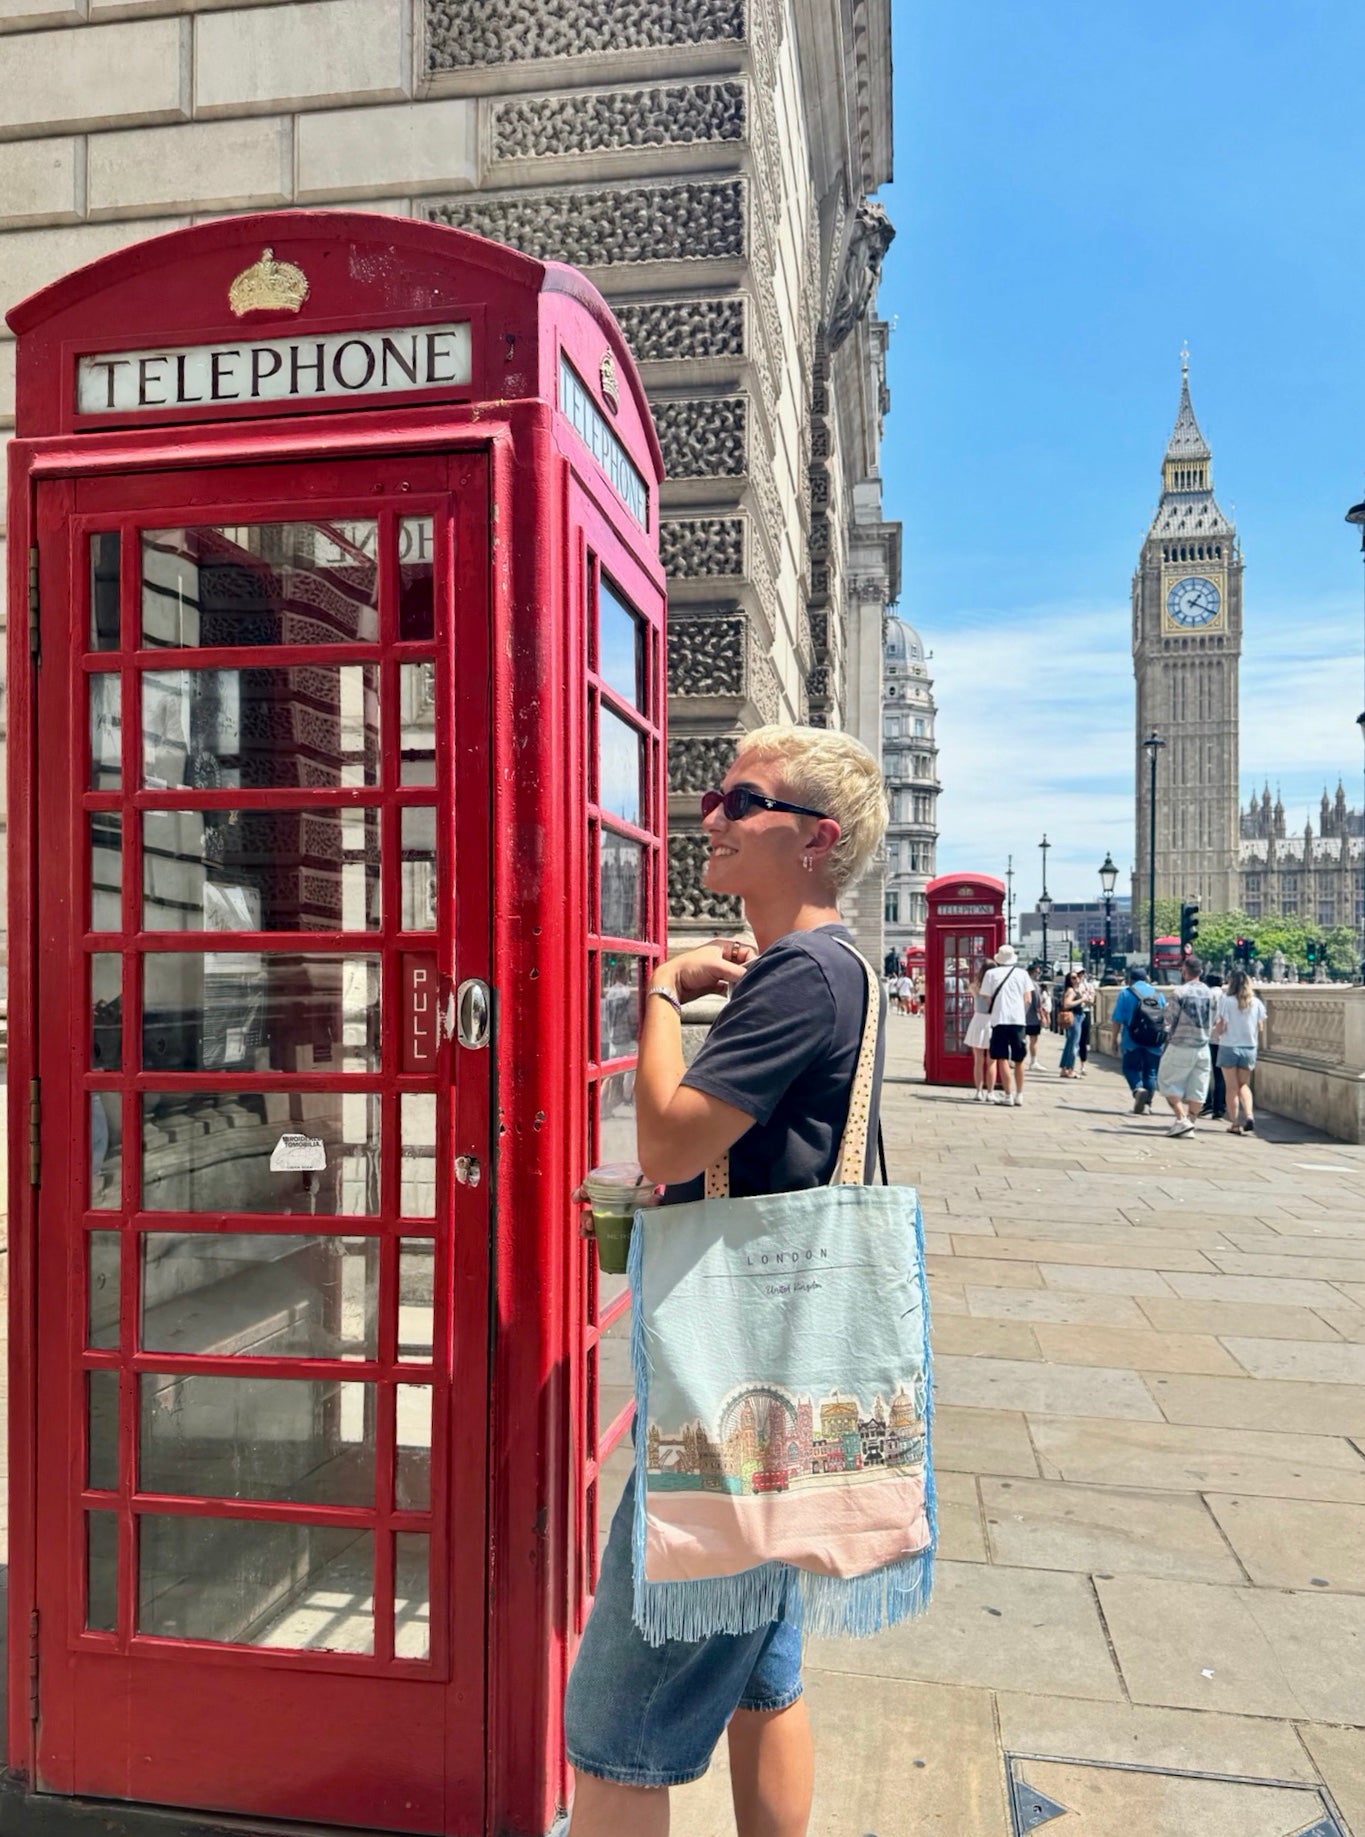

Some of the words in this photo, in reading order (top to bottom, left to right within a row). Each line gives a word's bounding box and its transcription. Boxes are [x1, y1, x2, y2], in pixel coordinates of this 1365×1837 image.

[93, 331, 457, 408] TELEPHONE
[563, 369, 643, 526] TELEPHONE
[413, 969, 427, 1059] PULL
[747, 1248, 828, 1266] LONDON
